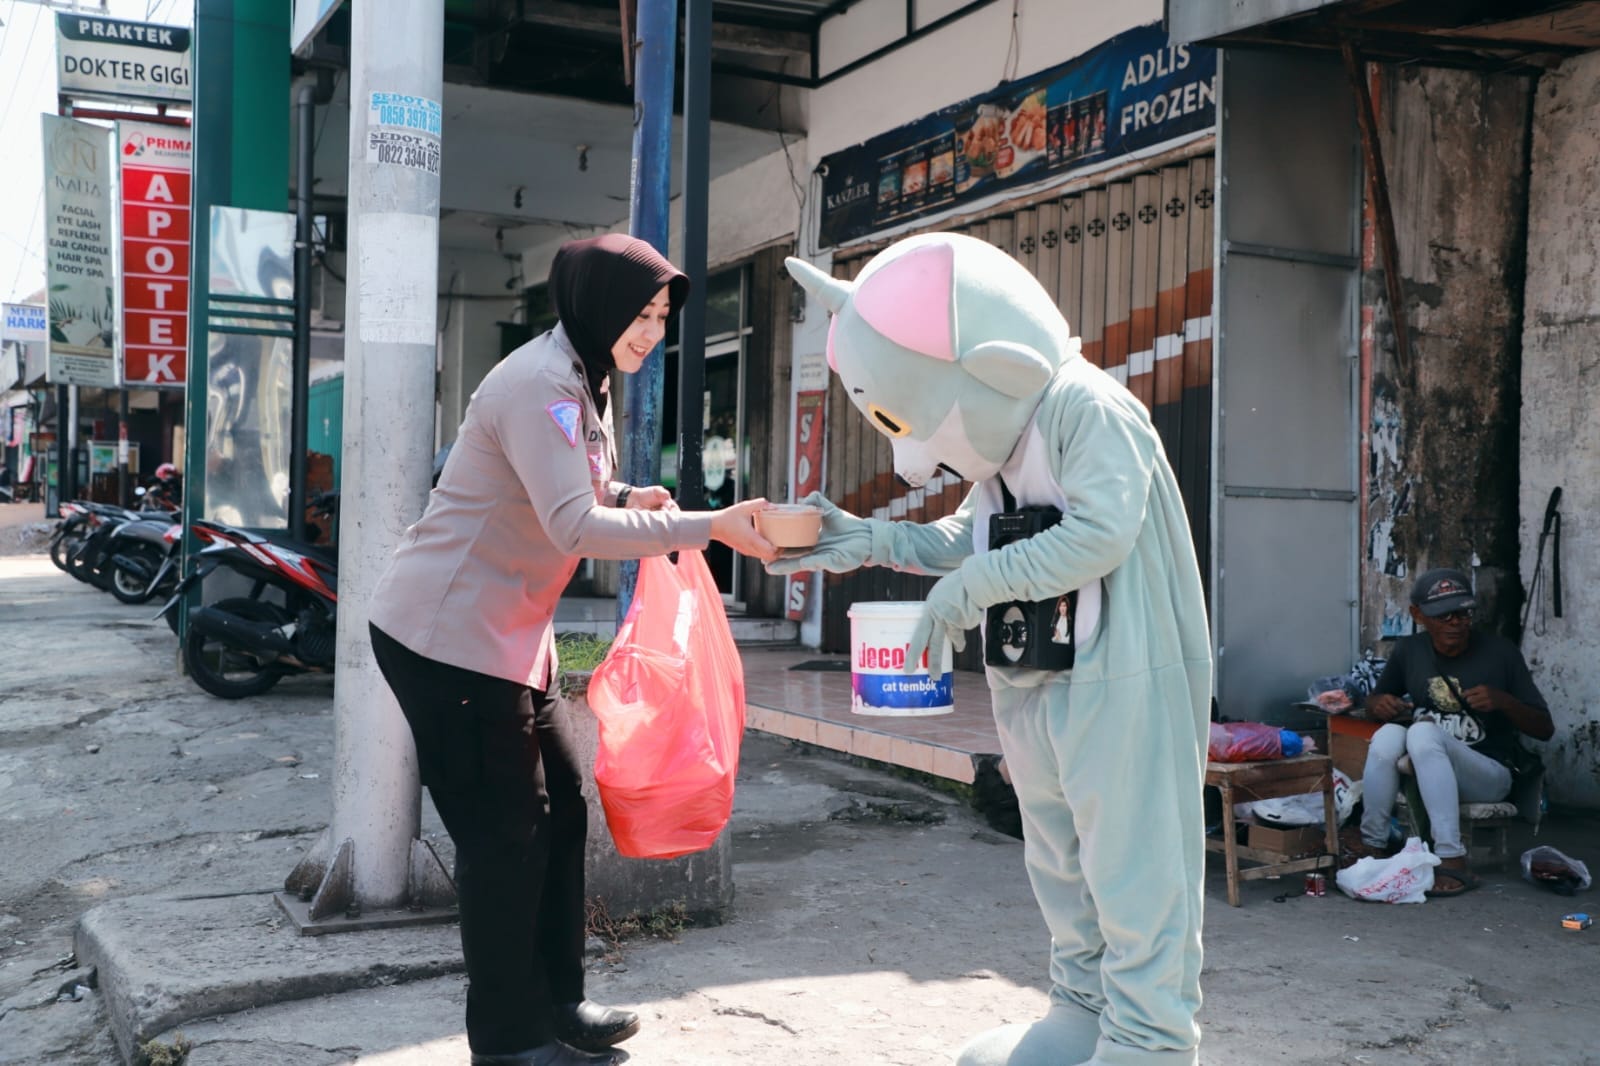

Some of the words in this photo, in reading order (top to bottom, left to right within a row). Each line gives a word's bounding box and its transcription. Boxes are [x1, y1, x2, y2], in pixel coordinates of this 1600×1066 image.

[78, 20, 173, 45] PRAKTEK
[64, 56, 146, 82] DOKTER
[150, 65, 189, 86] GIGI
[1121, 43, 1191, 92] ADLIS
[371, 92, 424, 106] SEDOT
[1121, 75, 1217, 136] FROZEN
[370, 132, 423, 145] SEDOT
[378, 144, 404, 164] 0822
[404, 147, 427, 170] 3344
[62, 204, 95, 218] FACIAL
[57, 216, 73, 226] EYE
[76, 219, 101, 231] LASH
[58, 228, 101, 242] REFLEKSI
[71, 241, 110, 256] CANDLE
[57, 252, 82, 264] HAIR
[84, 255, 103, 267] SPA
[56, 263, 84, 275] BODY
[86, 267, 104, 279] SPA
[145, 174, 177, 382] APOTEK
[882, 683, 897, 692] cat
[899, 680, 937, 692] tembok
